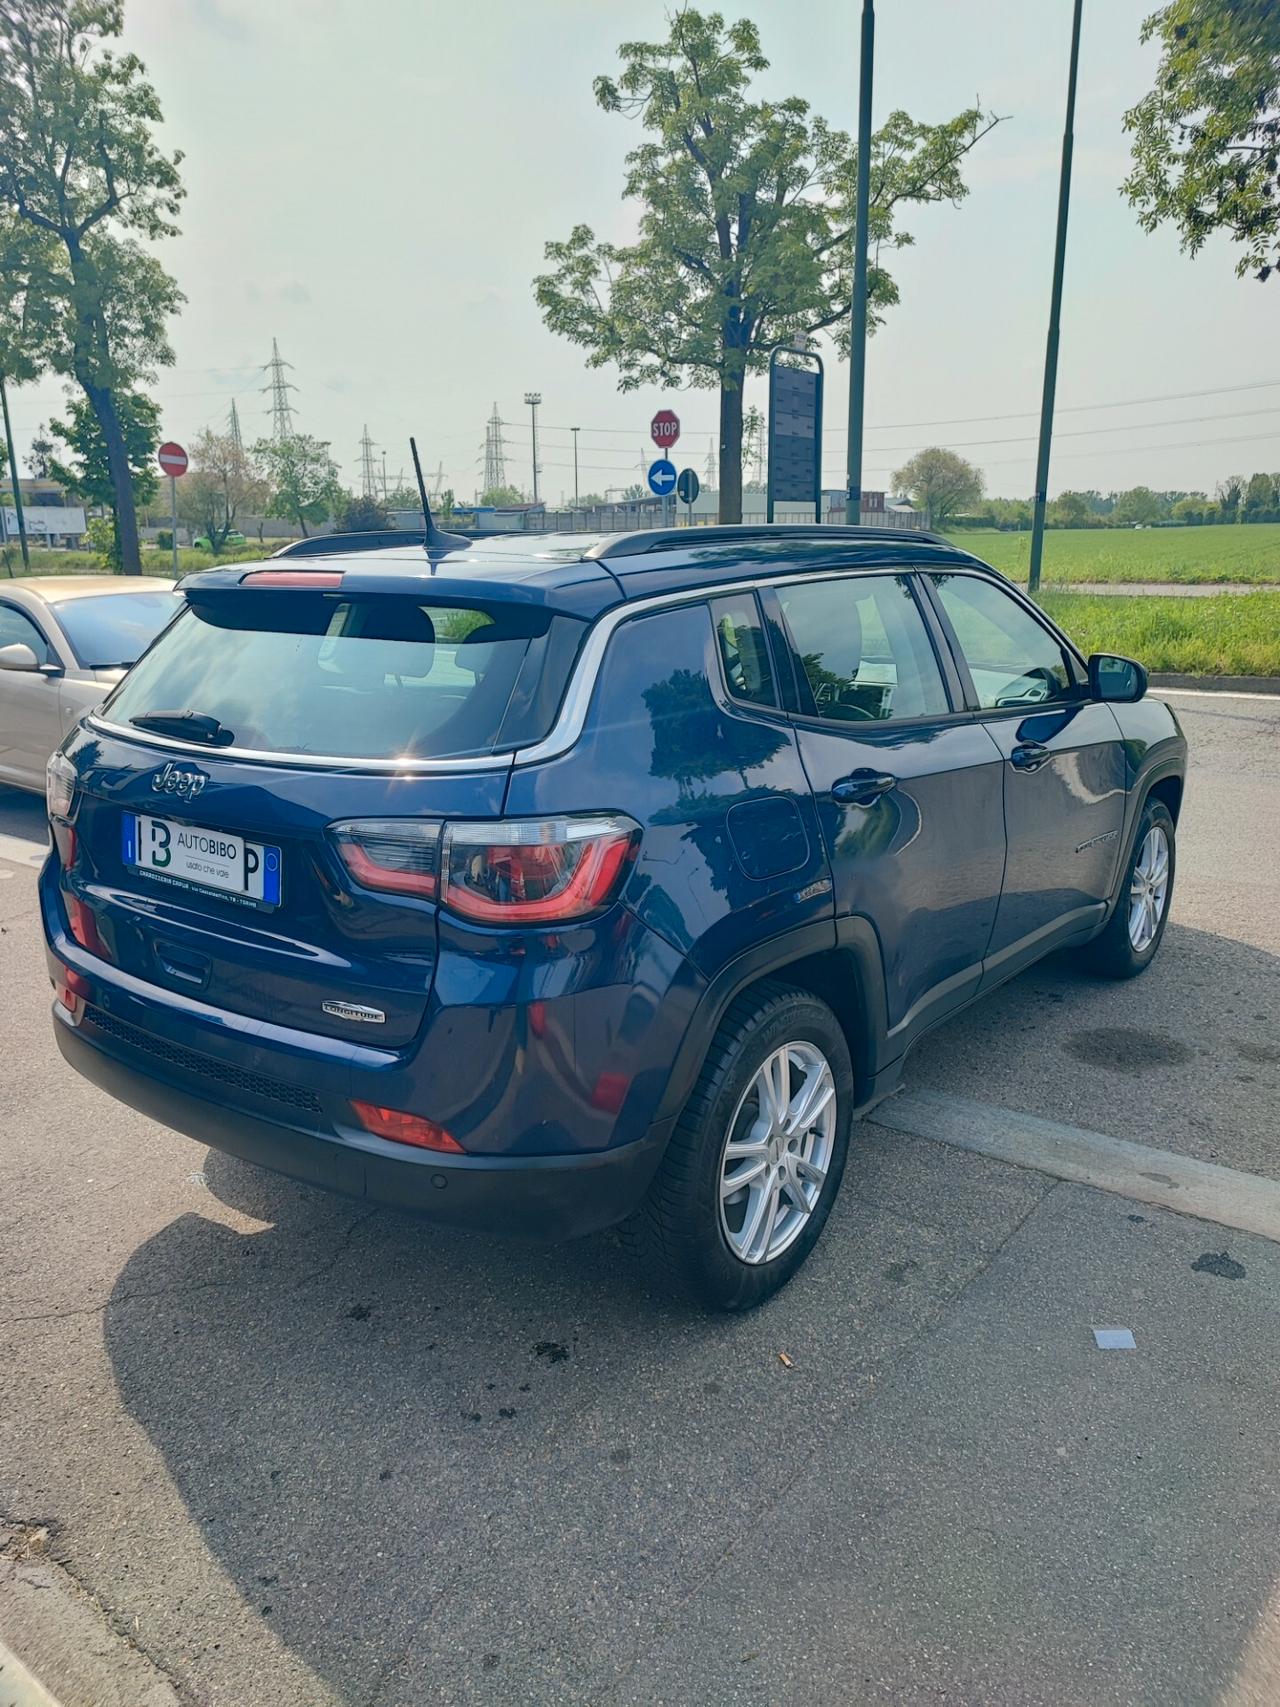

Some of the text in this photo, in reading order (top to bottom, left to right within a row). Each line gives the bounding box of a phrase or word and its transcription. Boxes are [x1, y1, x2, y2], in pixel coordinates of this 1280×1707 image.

[653, 421, 677, 436] STOP
[151, 763, 205, 804] Jeep
[177, 832, 237, 860] AUTOBIBO
[185, 861, 203, 873] usato
[203, 865, 216, 875] che
